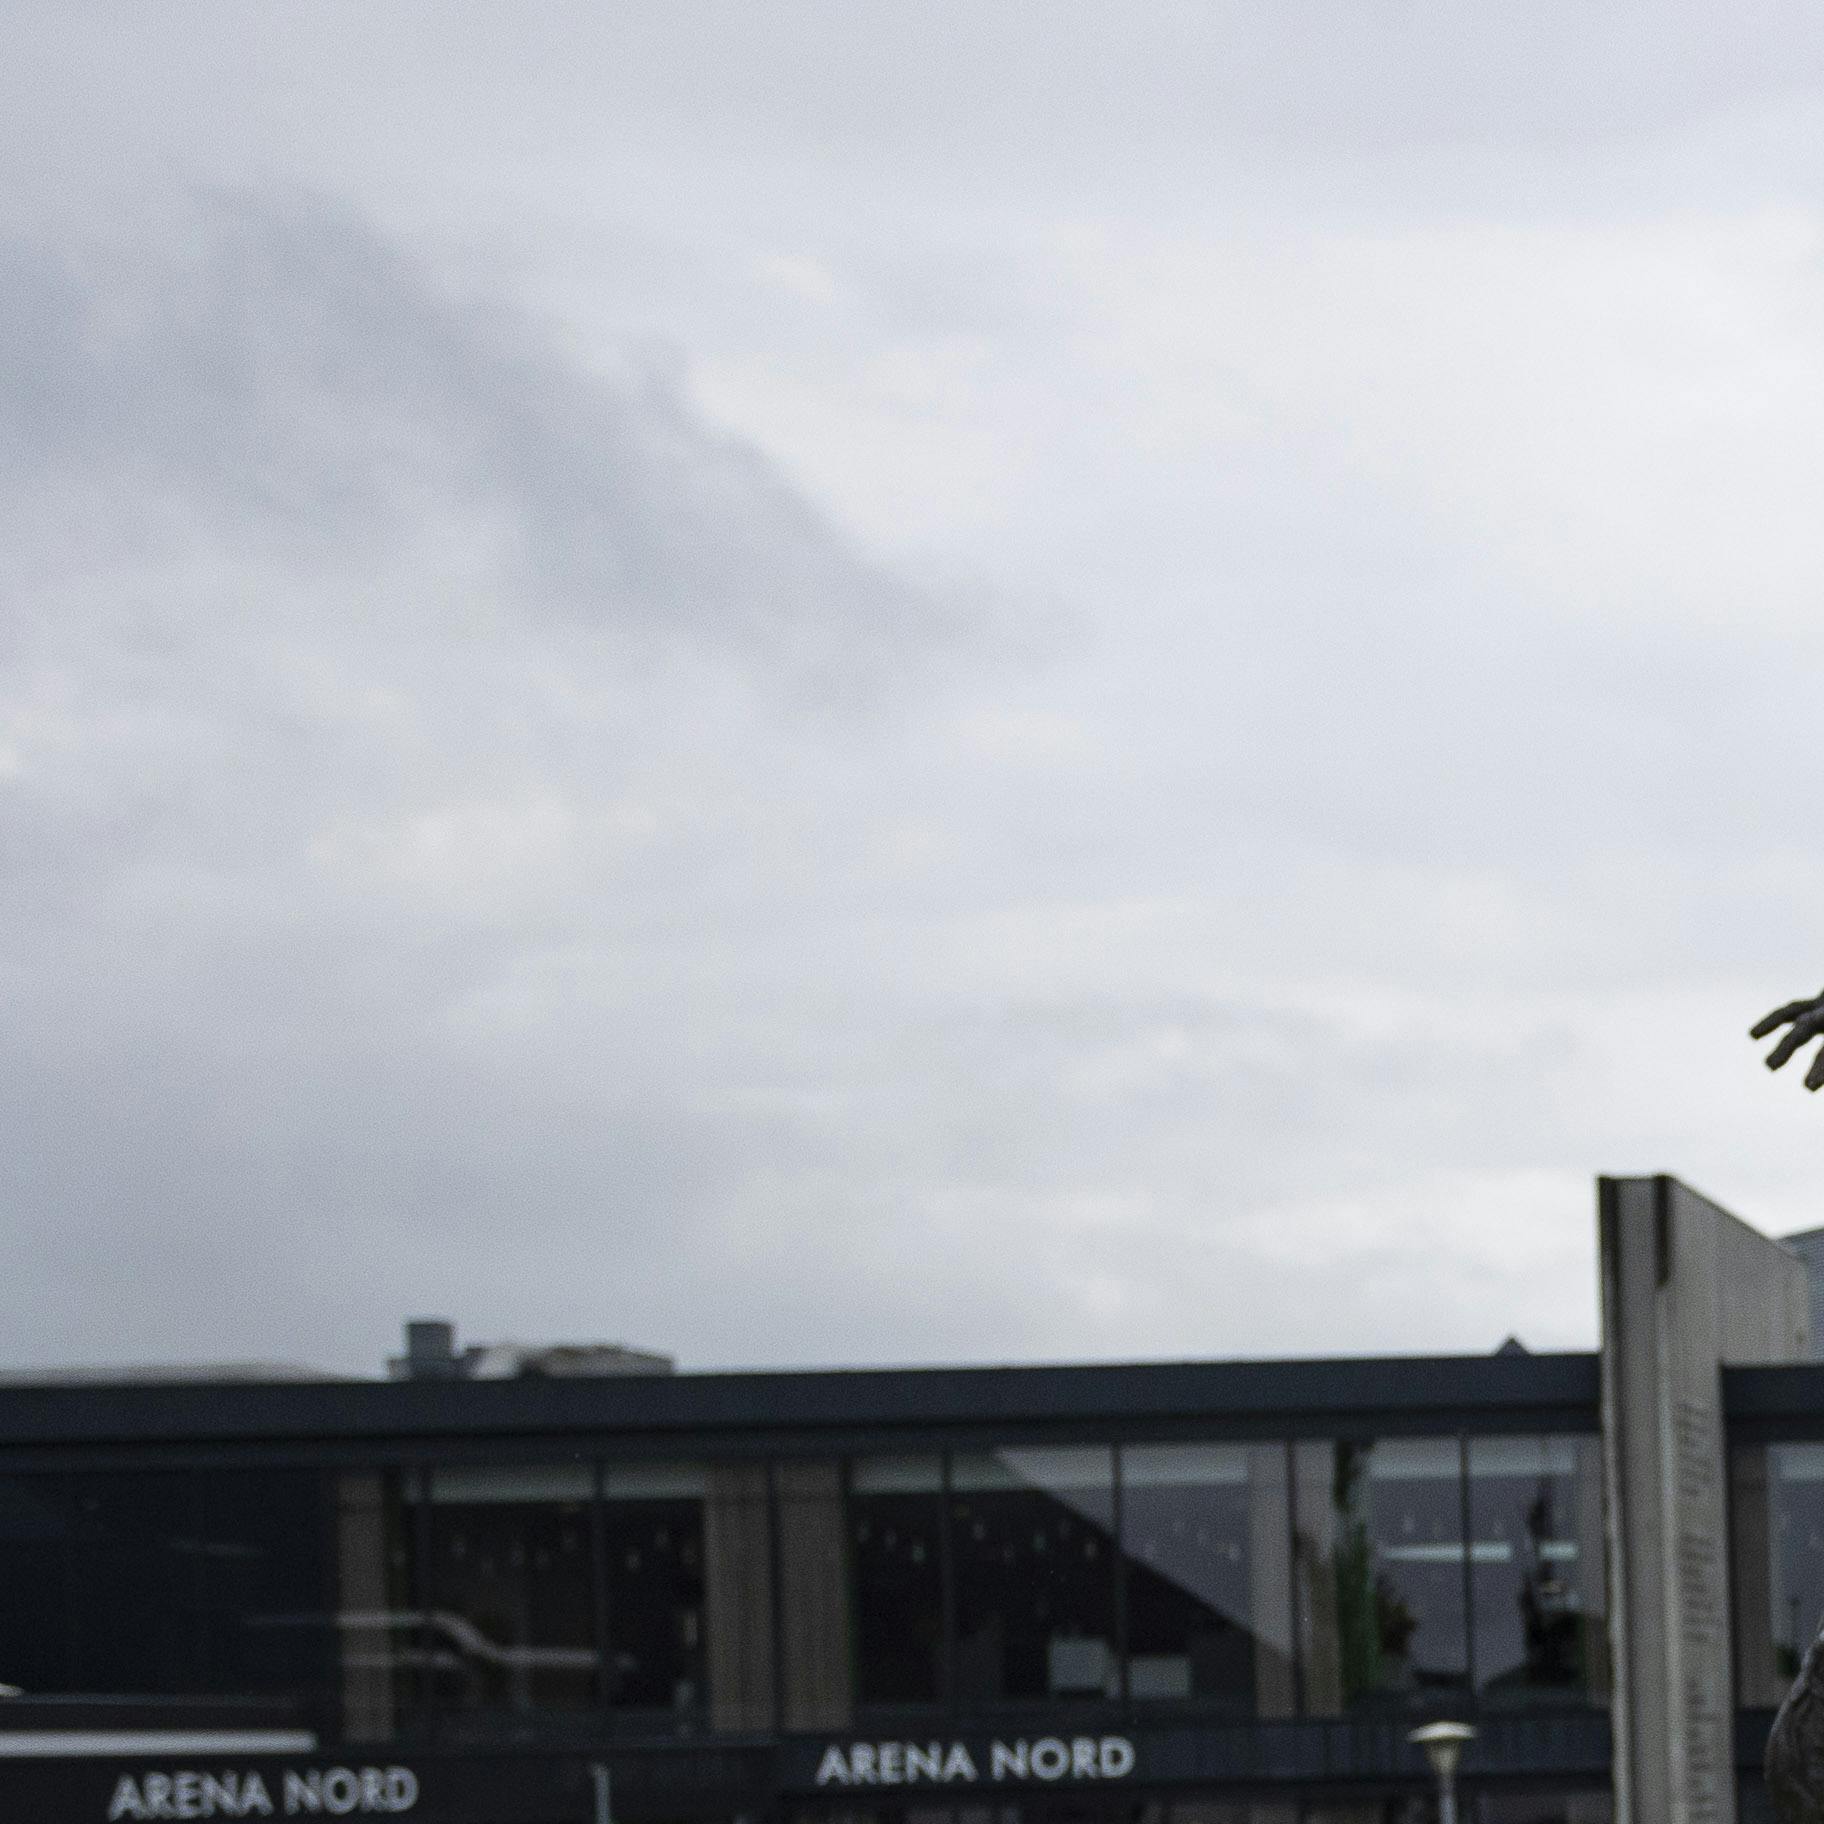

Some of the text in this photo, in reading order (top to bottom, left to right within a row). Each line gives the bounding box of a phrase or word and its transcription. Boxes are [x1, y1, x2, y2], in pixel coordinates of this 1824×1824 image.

[814, 1736, 1136, 1786] ARENA NORD
[108, 1766, 419, 1822] ARENA NORD
